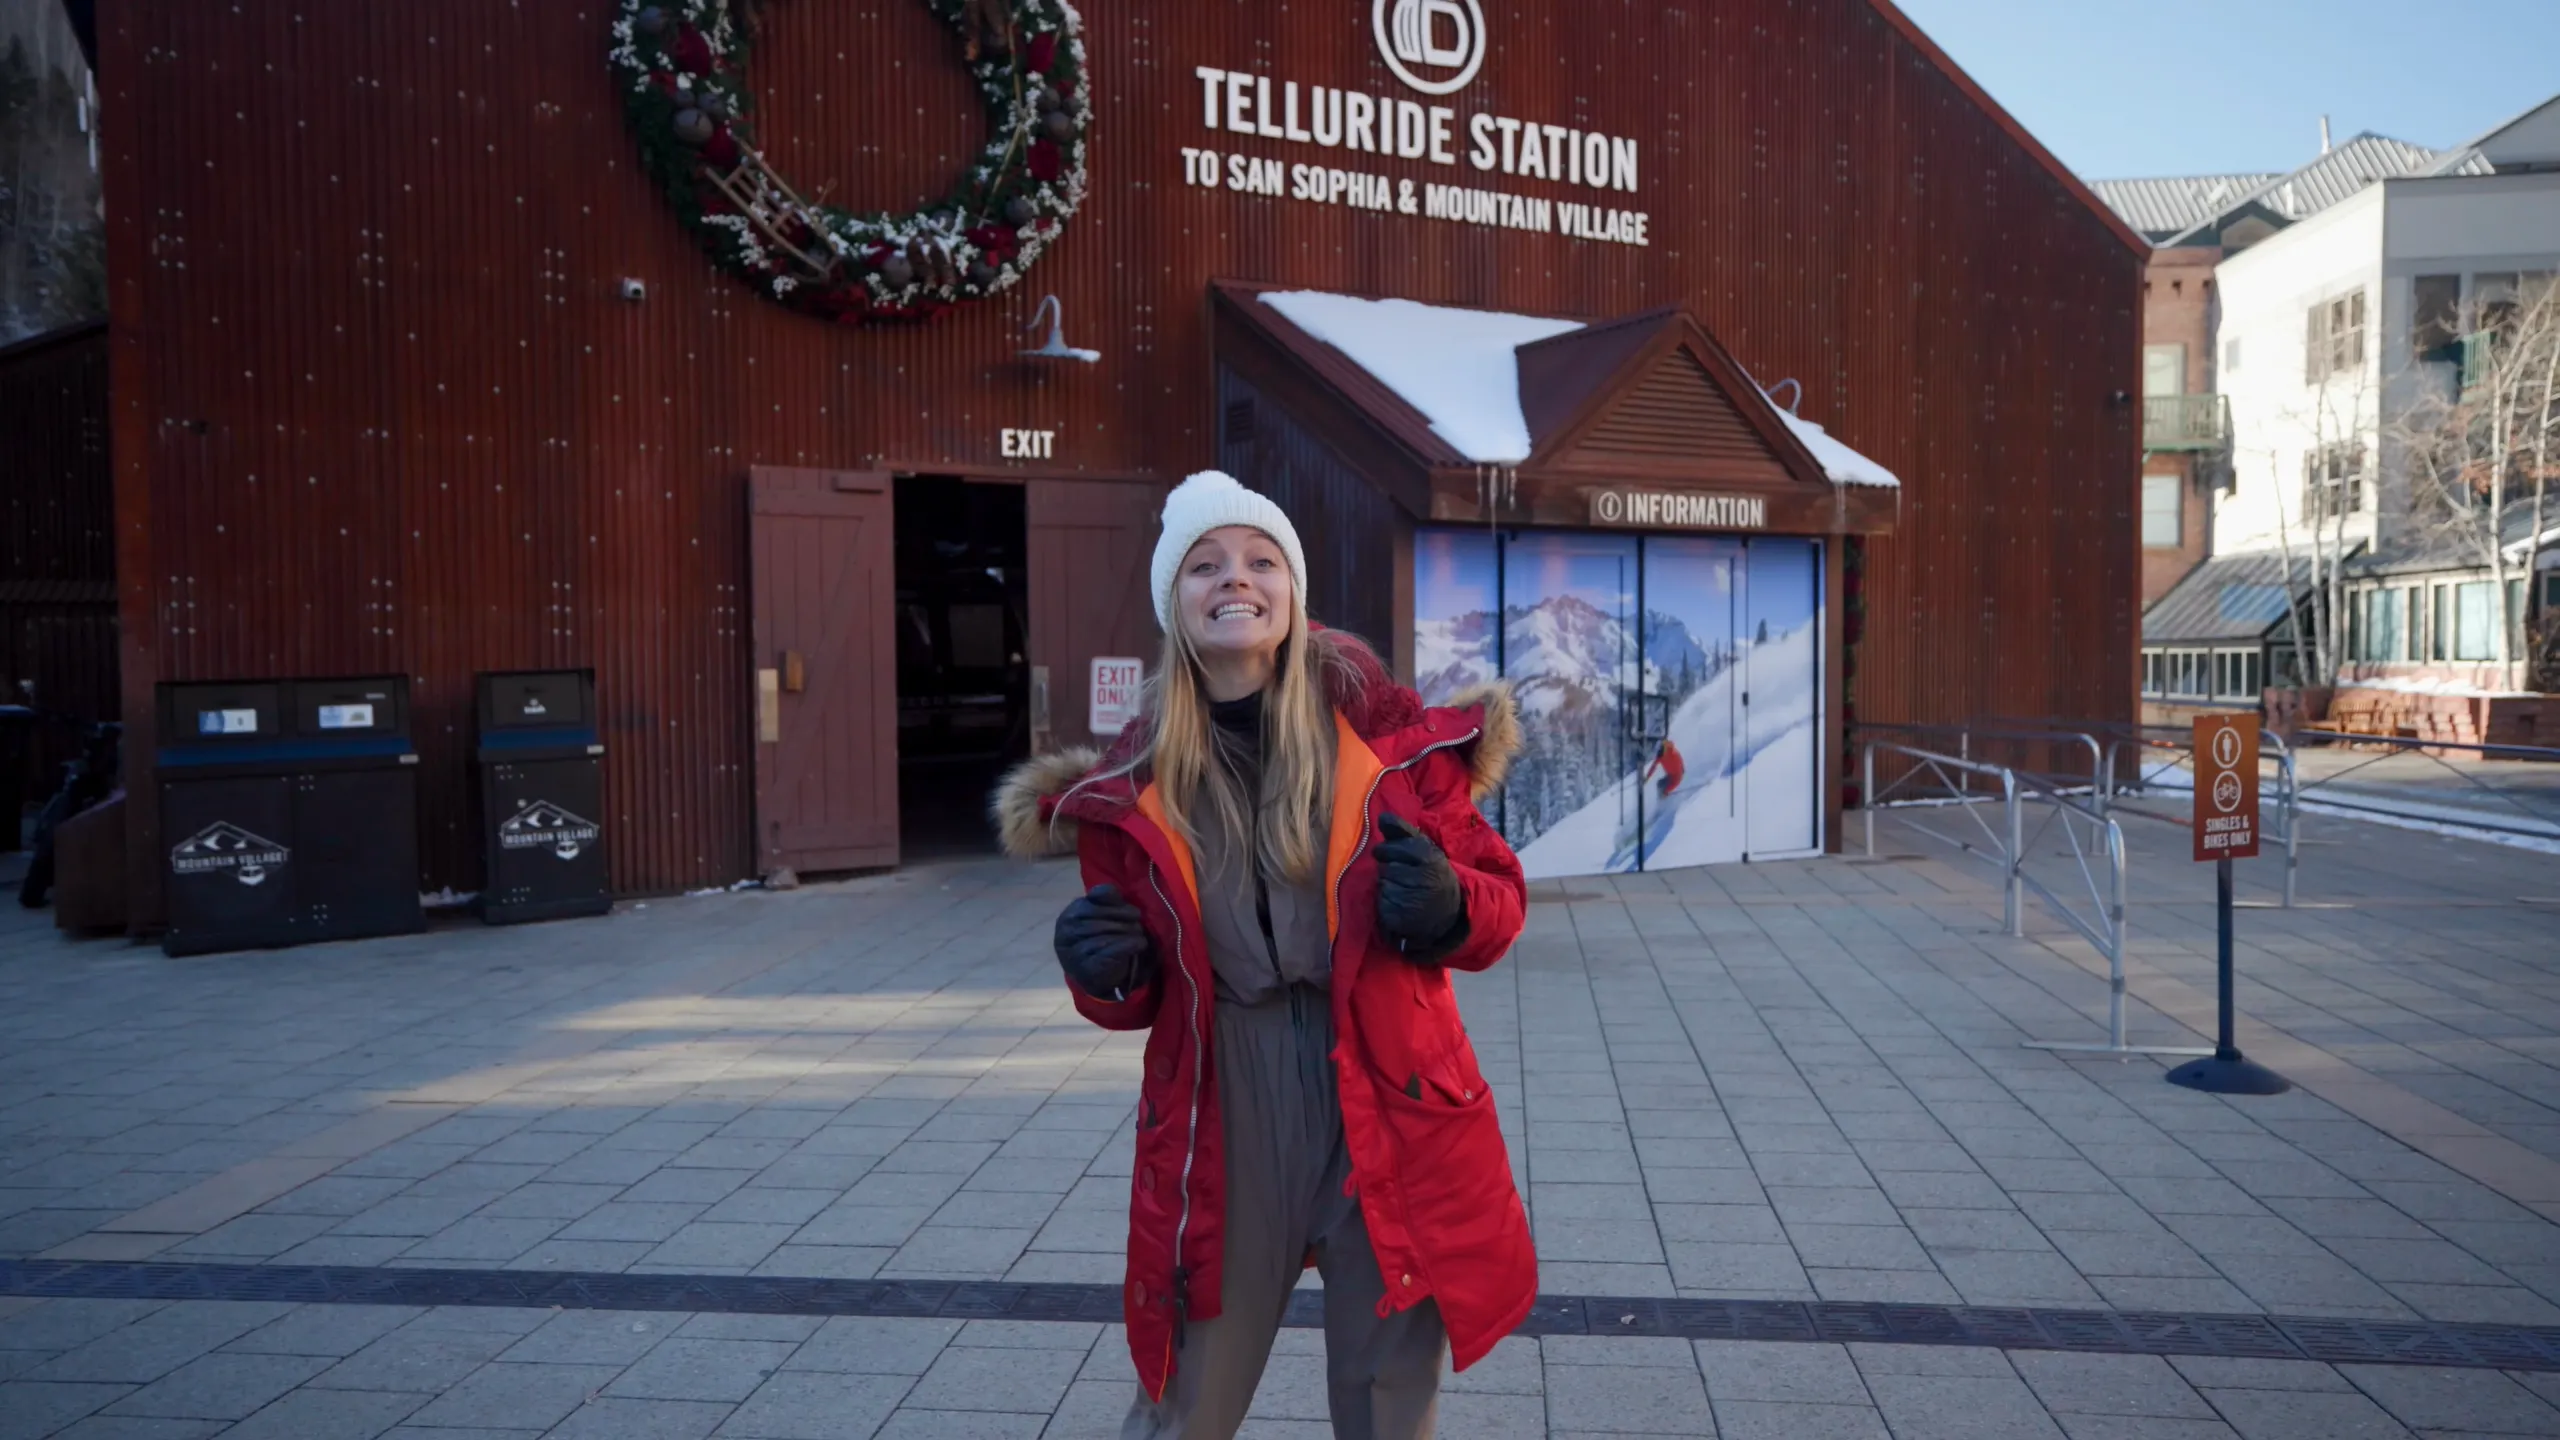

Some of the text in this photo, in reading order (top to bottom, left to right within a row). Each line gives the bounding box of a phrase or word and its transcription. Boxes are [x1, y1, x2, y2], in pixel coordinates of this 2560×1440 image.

[1196, 66, 1638, 192] TELLURIDE STATION
[1181, 147, 1649, 246] TO SAN SOPHIA & MOUNTAIN VILLAGE
[1001, 428, 1055, 458] EXIT
[1627, 492, 1764, 528] INFORMATION
[1098, 666, 1136, 685] EXIT
[2205, 814, 2250, 832] SINGLES &
[505, 832, 555, 844] MOUNTAIN
[2204, 830, 2252, 849] BIKES ONLY
[177, 856, 236, 869] MOUNTAIN
